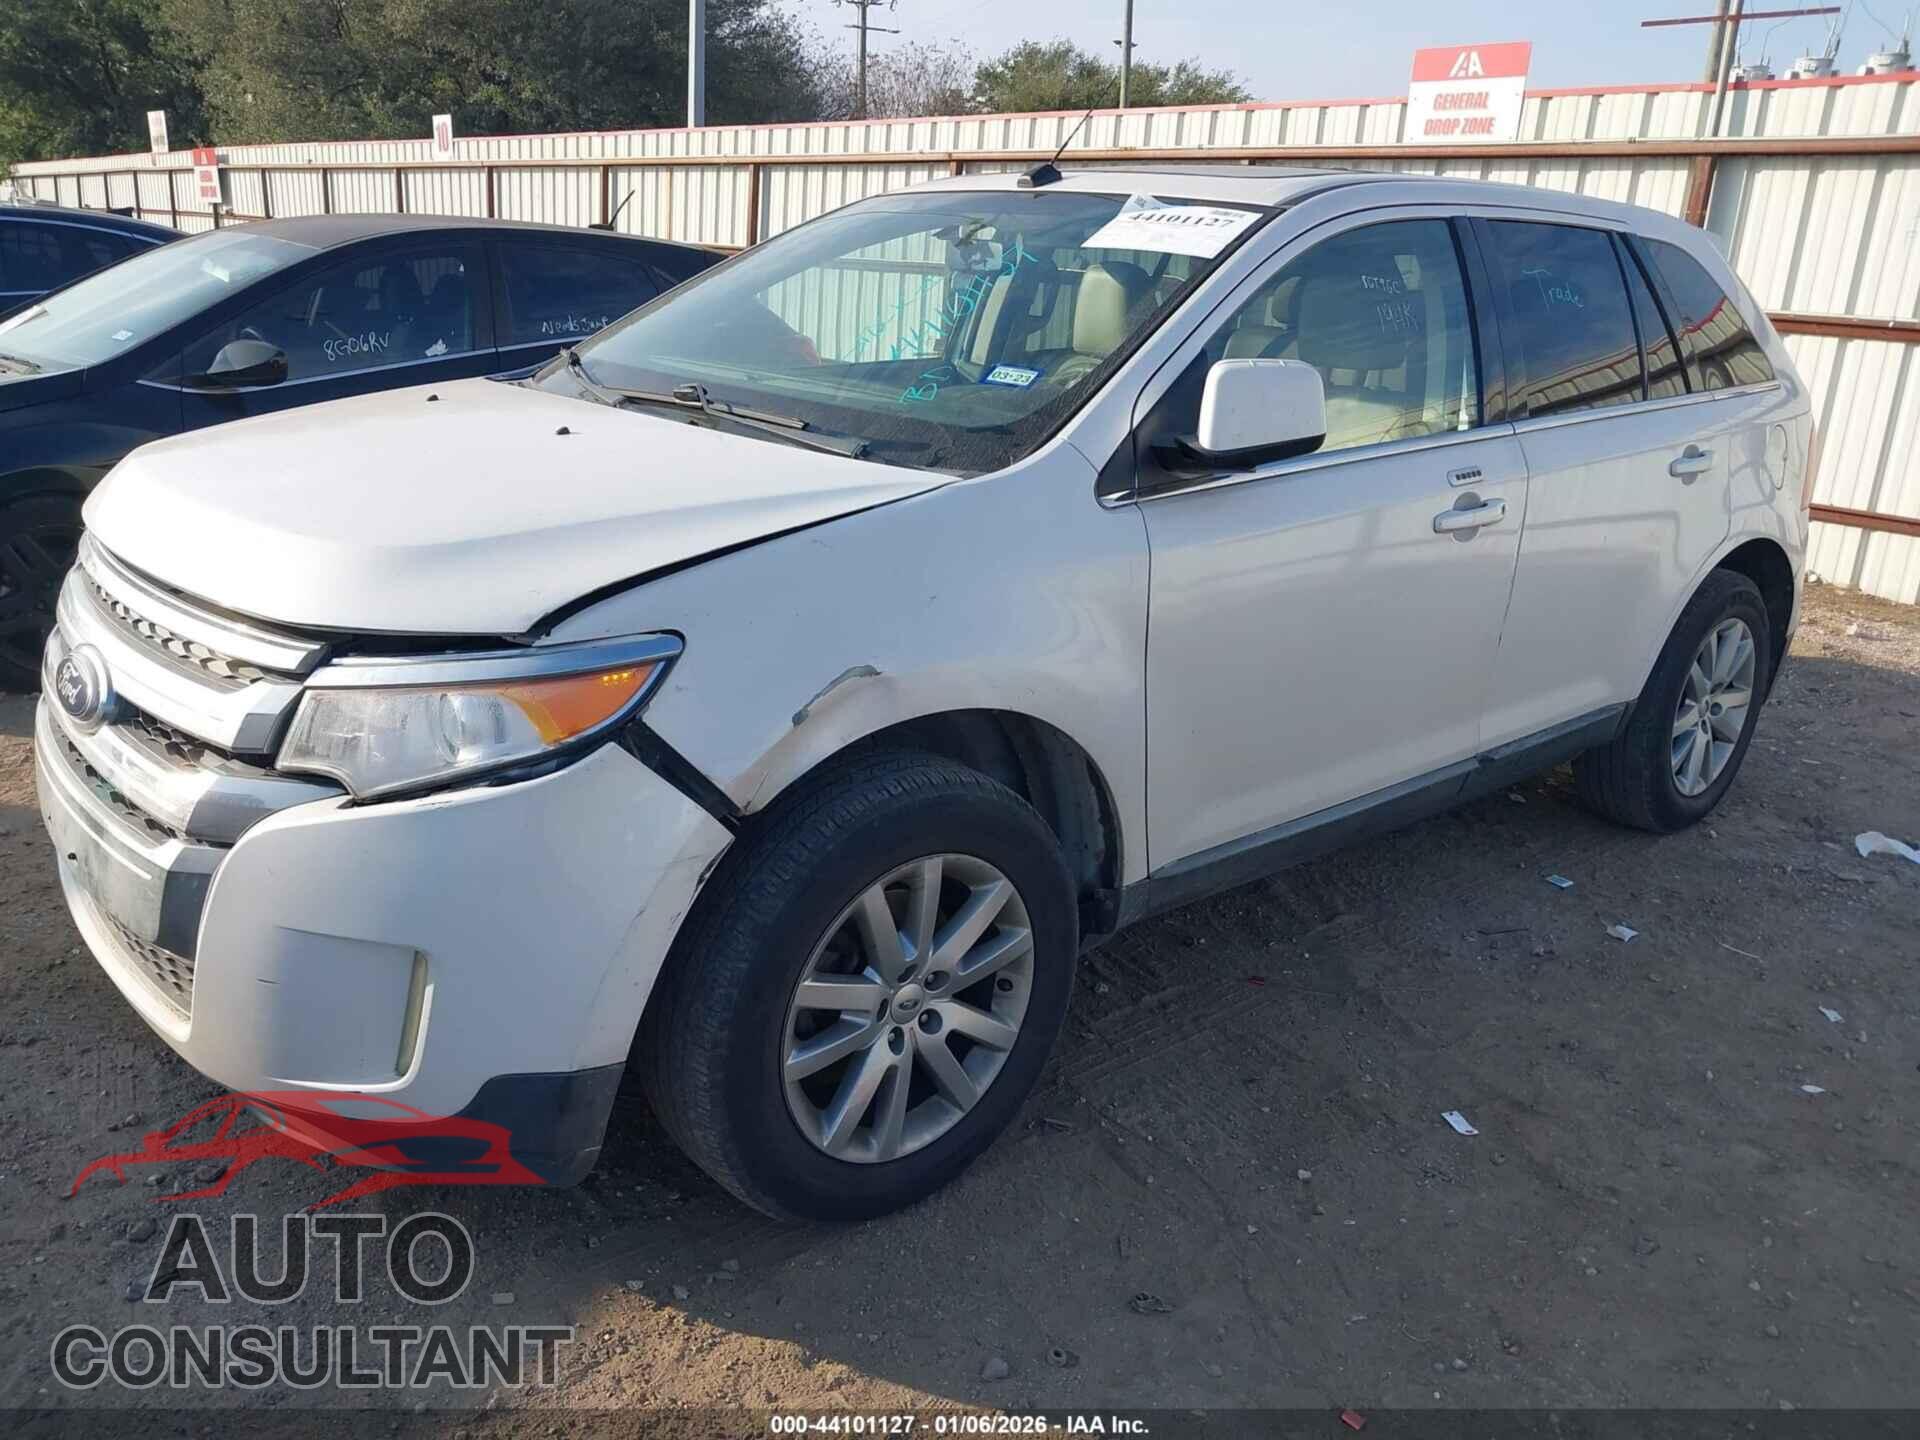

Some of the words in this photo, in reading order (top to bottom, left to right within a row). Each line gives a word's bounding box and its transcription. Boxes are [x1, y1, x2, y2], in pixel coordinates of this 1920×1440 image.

[1433, 91, 1490, 111] GENERAL
[1423, 118, 1460, 136] DROP
[1460, 116, 1497, 135] ZONE
[1128, 212, 1236, 228] 44101127
[58, 661, 82, 705] Ford
